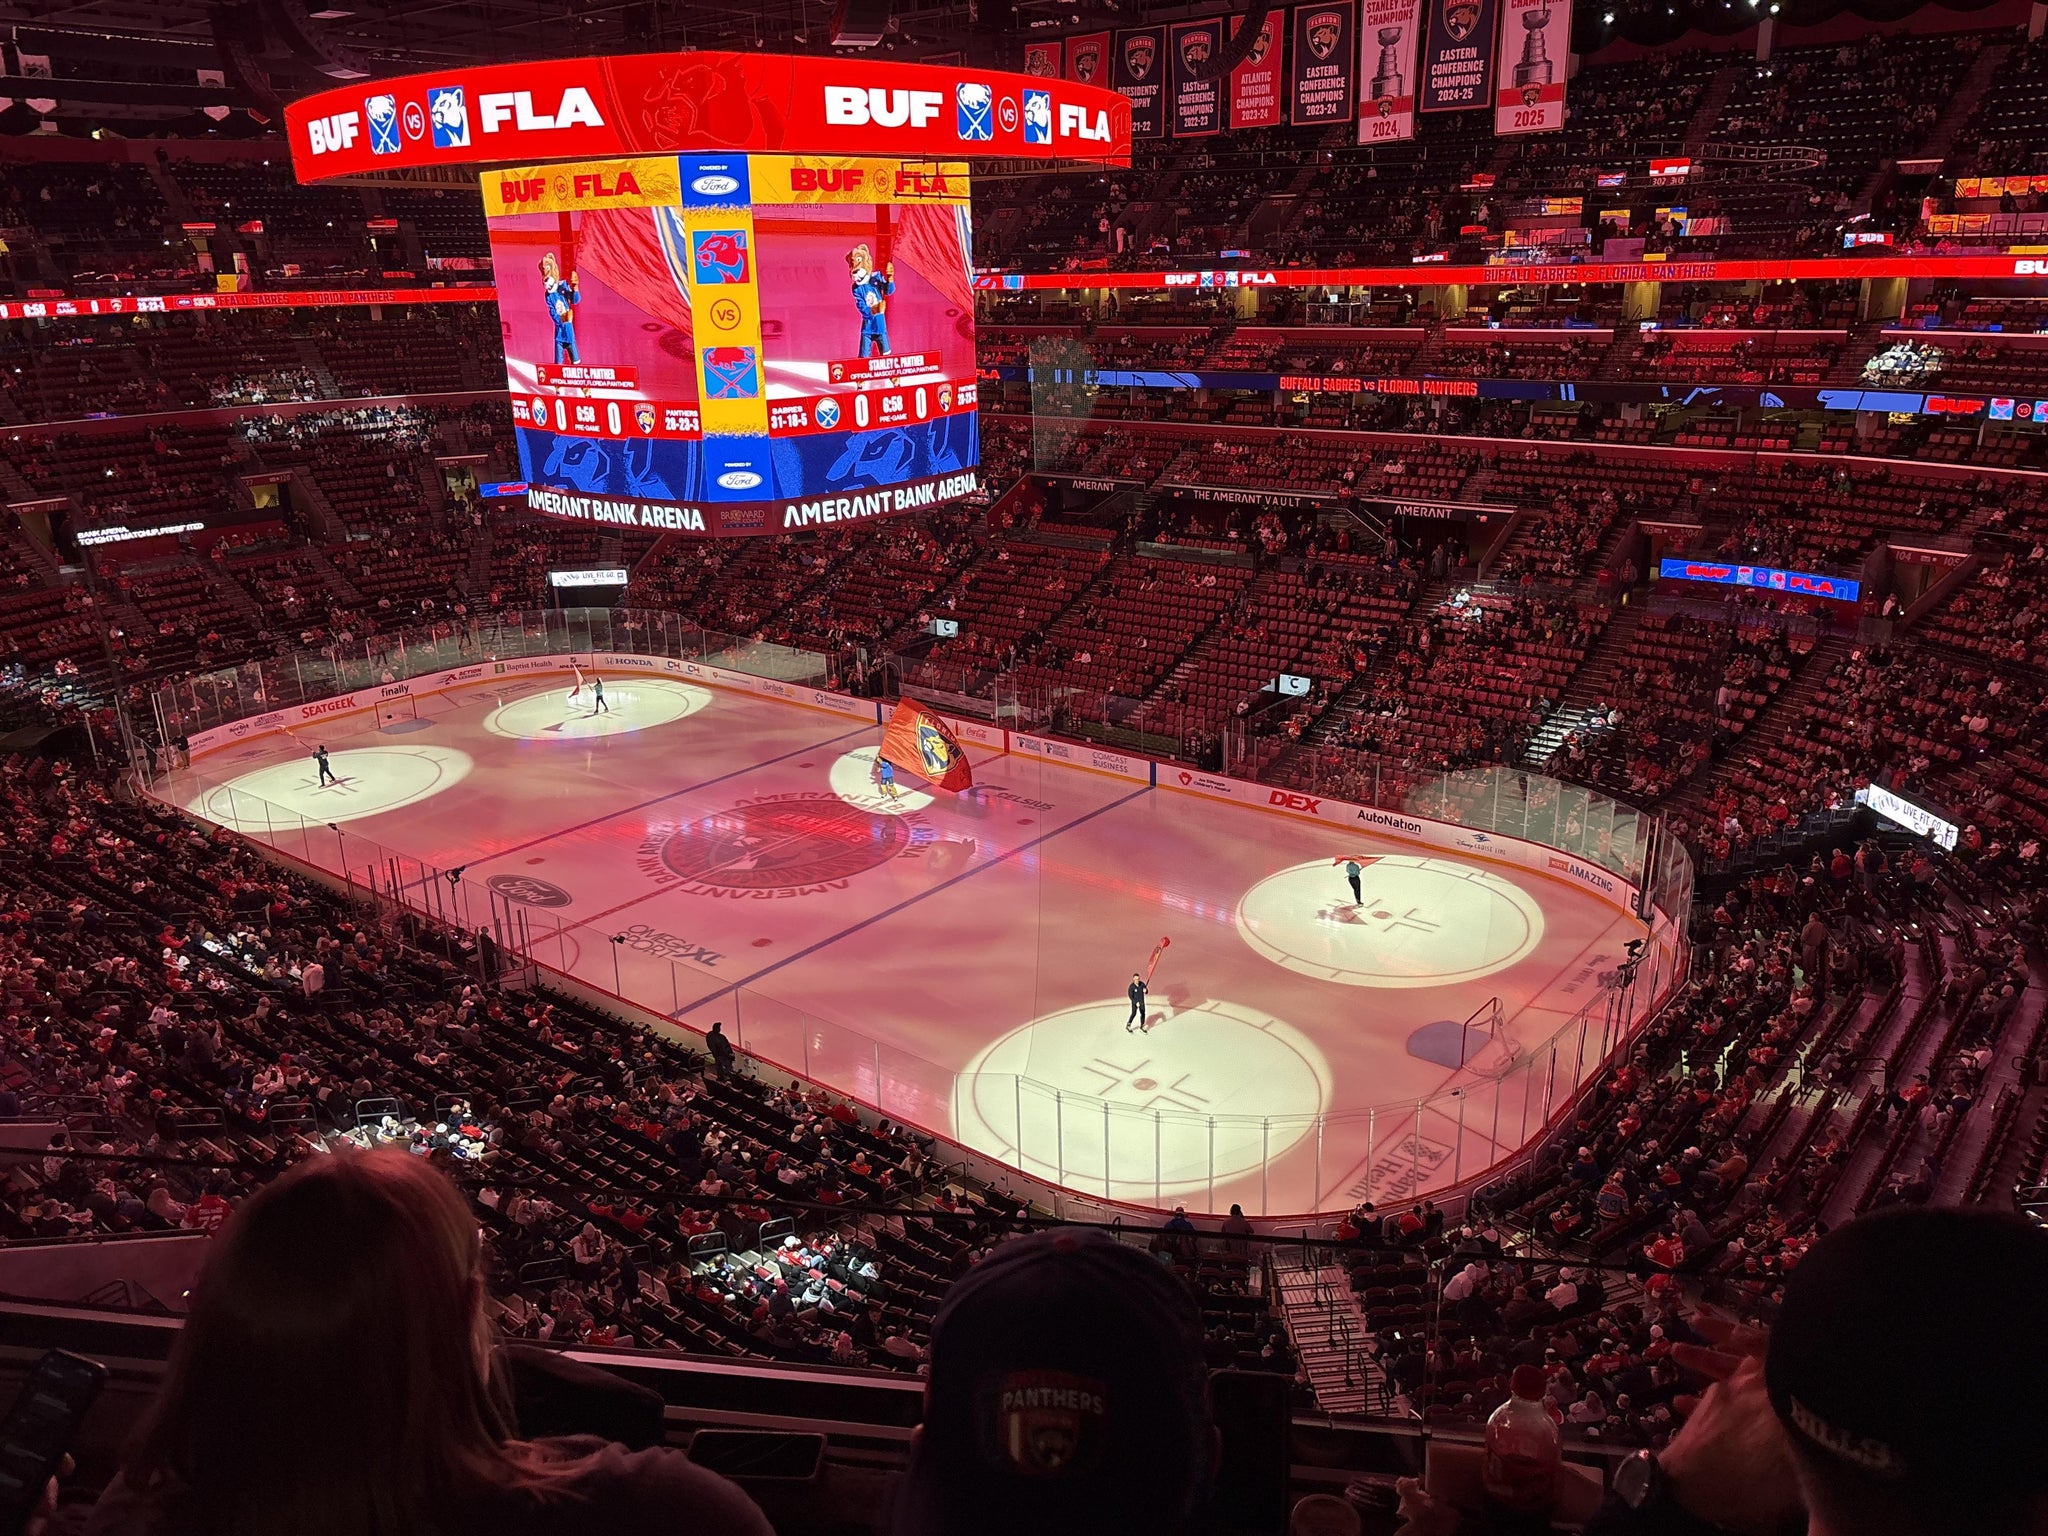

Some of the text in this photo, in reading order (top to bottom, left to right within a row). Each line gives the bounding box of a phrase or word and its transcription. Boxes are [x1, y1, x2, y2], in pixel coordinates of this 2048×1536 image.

[1368, 9, 1414, 26] CHAMPIONS
[1440, 47, 1477, 62] EASTERN
[1306, 65, 1339, 79] EASTERN
[1431, 60, 1484, 76] CONFERENCE
[1241, 71, 1272, 85] ATLANTIC
[1299, 78, 1345, 92] CONFERENCE
[1431, 74, 1482, 89] CHAMPIONS
[1178, 92, 1215, 104] CONFERENCE
[1241, 84, 1271, 97] DIVISION
[1300, 90, 1344, 104] CHAMPIONS
[1437, 88, 1474, 102] 2024-25
[1236, 95, 1274, 109] CHAMPIONS
[824, 85, 1111, 142] BUF VS FLA
[1179, 104, 1214, 116] CHAMPIONS
[1241, 109, 1268, 121] 2023-24
[1306, 104, 1337, 116] 2023-24
[308, 87, 604, 155] BUF VS FLA
[1184, 116, 1209, 127] 2022-23
[1514, 109, 1544, 127] 2025
[1372, 119, 1398, 138] 2024
[501, 178, 546, 203] BUF
[574, 171, 641, 198] FLA
[700, 177, 730, 192] Ford
[790, 168, 948, 193] BUF VS FLA
[1165, 273, 1276, 285] BUF FLA
[1484, 263, 1716, 282] BUFFALO SABRES FLORIDA PANTHERS
[251, 291, 396, 305] SABRES FLORIDA PANTHERS
[23, 303, 46, 318] 6:58
[90, 300, 99, 313] 0
[716, 309, 734, 321] VS
[868, 357, 893, 371] STANLEY
[901, 355, 925, 369] PANTHER
[562, 367, 583, 379] STANLEY
[589, 368, 615, 380] PANTHER
[850, 371, 873, 380] OFFICIAL
[896, 366, 917, 375] FLORIDA
[916, 364, 939, 373] PANTHERS
[975, 369, 1000, 379] FLA
[1280, 376, 1320, 391] BUFFALO
[1323, 377, 1361, 392] SABRES
[1377, 379, 1420, 394] FLORIDA
[1423, 381, 1478, 396] PANTHERS
[771, 406, 803, 415] SABRES
[854, 394, 870, 427] 0
[882, 395, 904, 413] 6:58
[915, 387, 928, 419] 0
[1927, 398, 1985, 414] BUF
[555, 398, 567, 431] 0
[576, 405, 596, 422] 6:58
[607, 401, 622, 435] 0
[665, 409, 699, 418] PANTHERS
[879, 413, 907, 423] PRE-GAME
[574, 424, 600, 432] PRE-GAME
[665, 417, 700, 432] 28-23-3
[771, 413, 808, 430] 31-18-5
[726, 473, 755, 487] Ford
[1072, 480, 1115, 492] AMERANT
[783, 472, 978, 528] AMERANT BANK ARENA
[1193, 490, 1300, 507] THE AMERANT VAULT
[528, 488, 705, 531] AMERANT BANK ARENA
[720, 509, 765, 520] BROWARD
[1394, 505, 1452, 520] AMERANT
[77, 529, 100, 539] BANK
[1895, 551, 1912, 561] 104
[1790, 577, 1834, 594] FLA
[506, 662, 529, 672] Baptist
[531, 660, 553, 668] Health
[615, 658, 655, 667] HONDA
[459, 667, 482, 676] ACTION
[381, 684, 409, 698] finally
[302, 695, 357, 719] SEATGEEK
[1092, 751, 1128, 765] COMCAST
[1092, 759, 1128, 774] BUSINESS
[997, 792, 1055, 810] CELSIUS
[1268, 790, 1322, 815] DEX
[1357, 809, 1422, 833] AutoNation
[1569, 864, 1613, 893] AMAZING
[498, 879, 556, 903] Ford
[680, 878, 851, 900] AMERANT
[627, 924, 696, 952] OMEGA
[1003, 1387, 1104, 1415] PANTHERS
